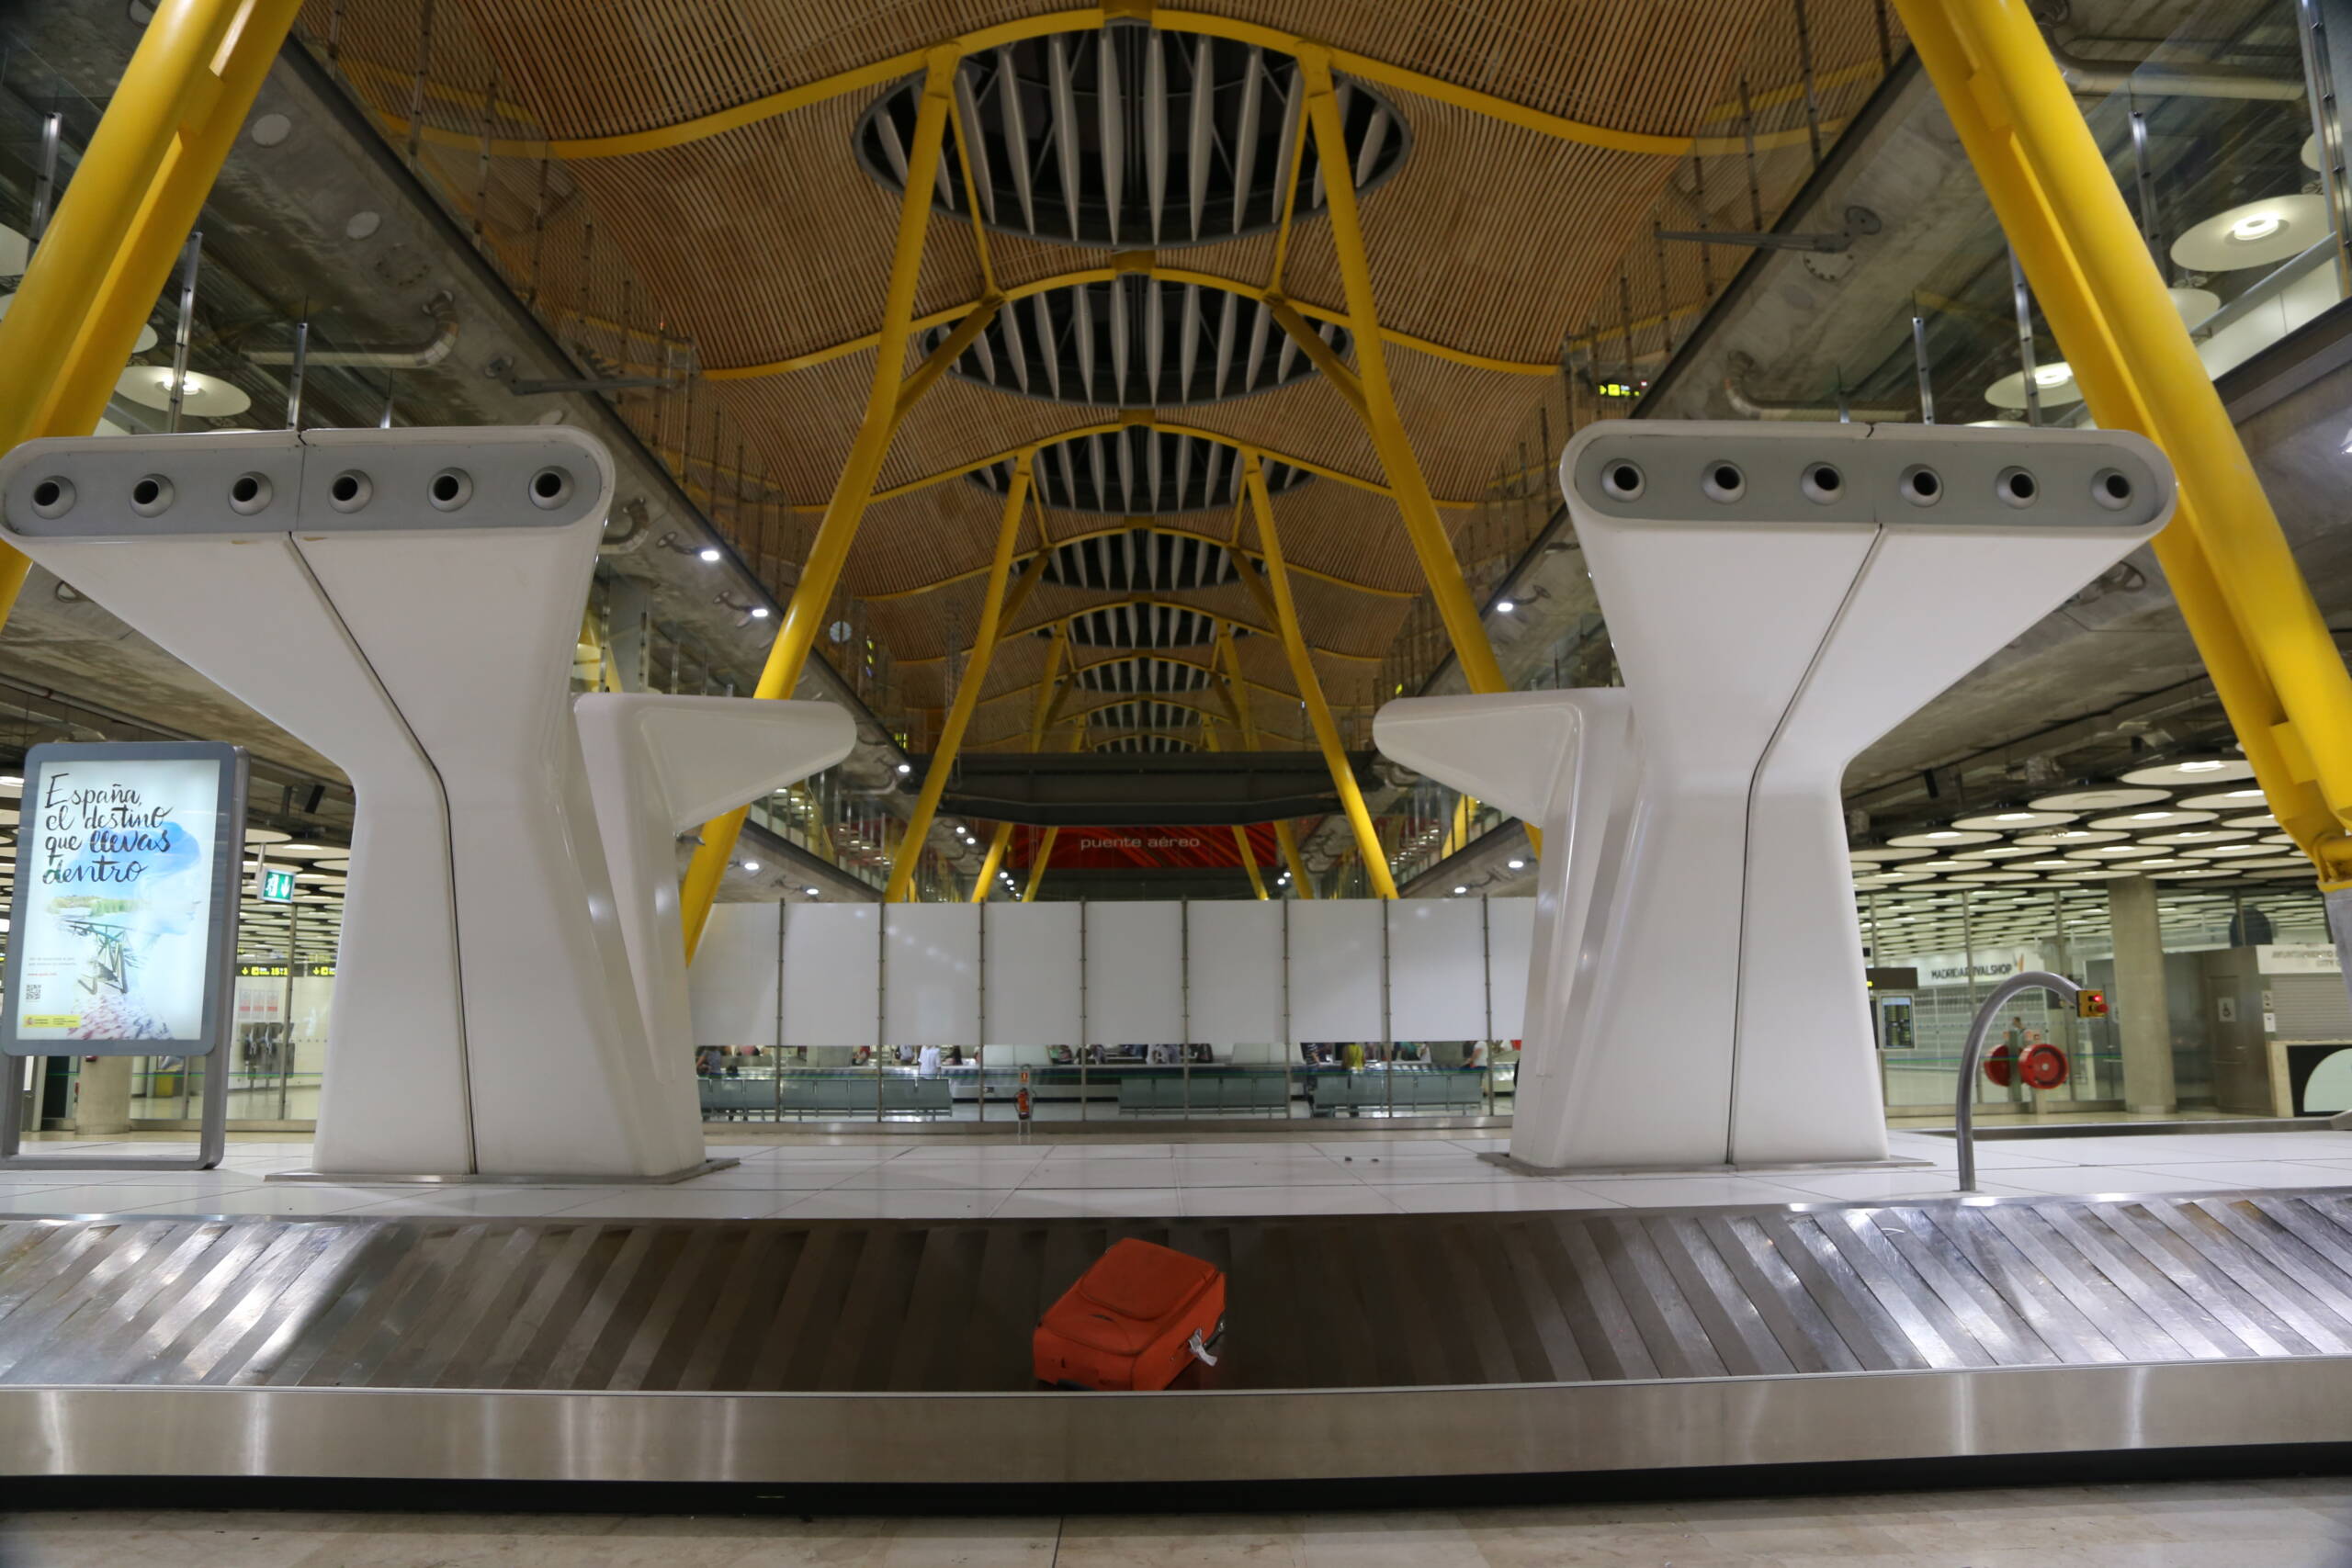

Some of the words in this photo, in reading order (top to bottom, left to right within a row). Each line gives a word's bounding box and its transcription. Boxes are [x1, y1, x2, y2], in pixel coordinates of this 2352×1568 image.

[45, 773, 142, 819] España,
[46, 805, 75, 831] el
[85, 805, 175, 829] destino
[45, 835, 83, 867] que
[90, 829, 171, 853] llevas
[1080, 837, 1142, 852] puente
[1148, 835, 1201, 848] aéreo
[42, 855, 150, 885] dentro
